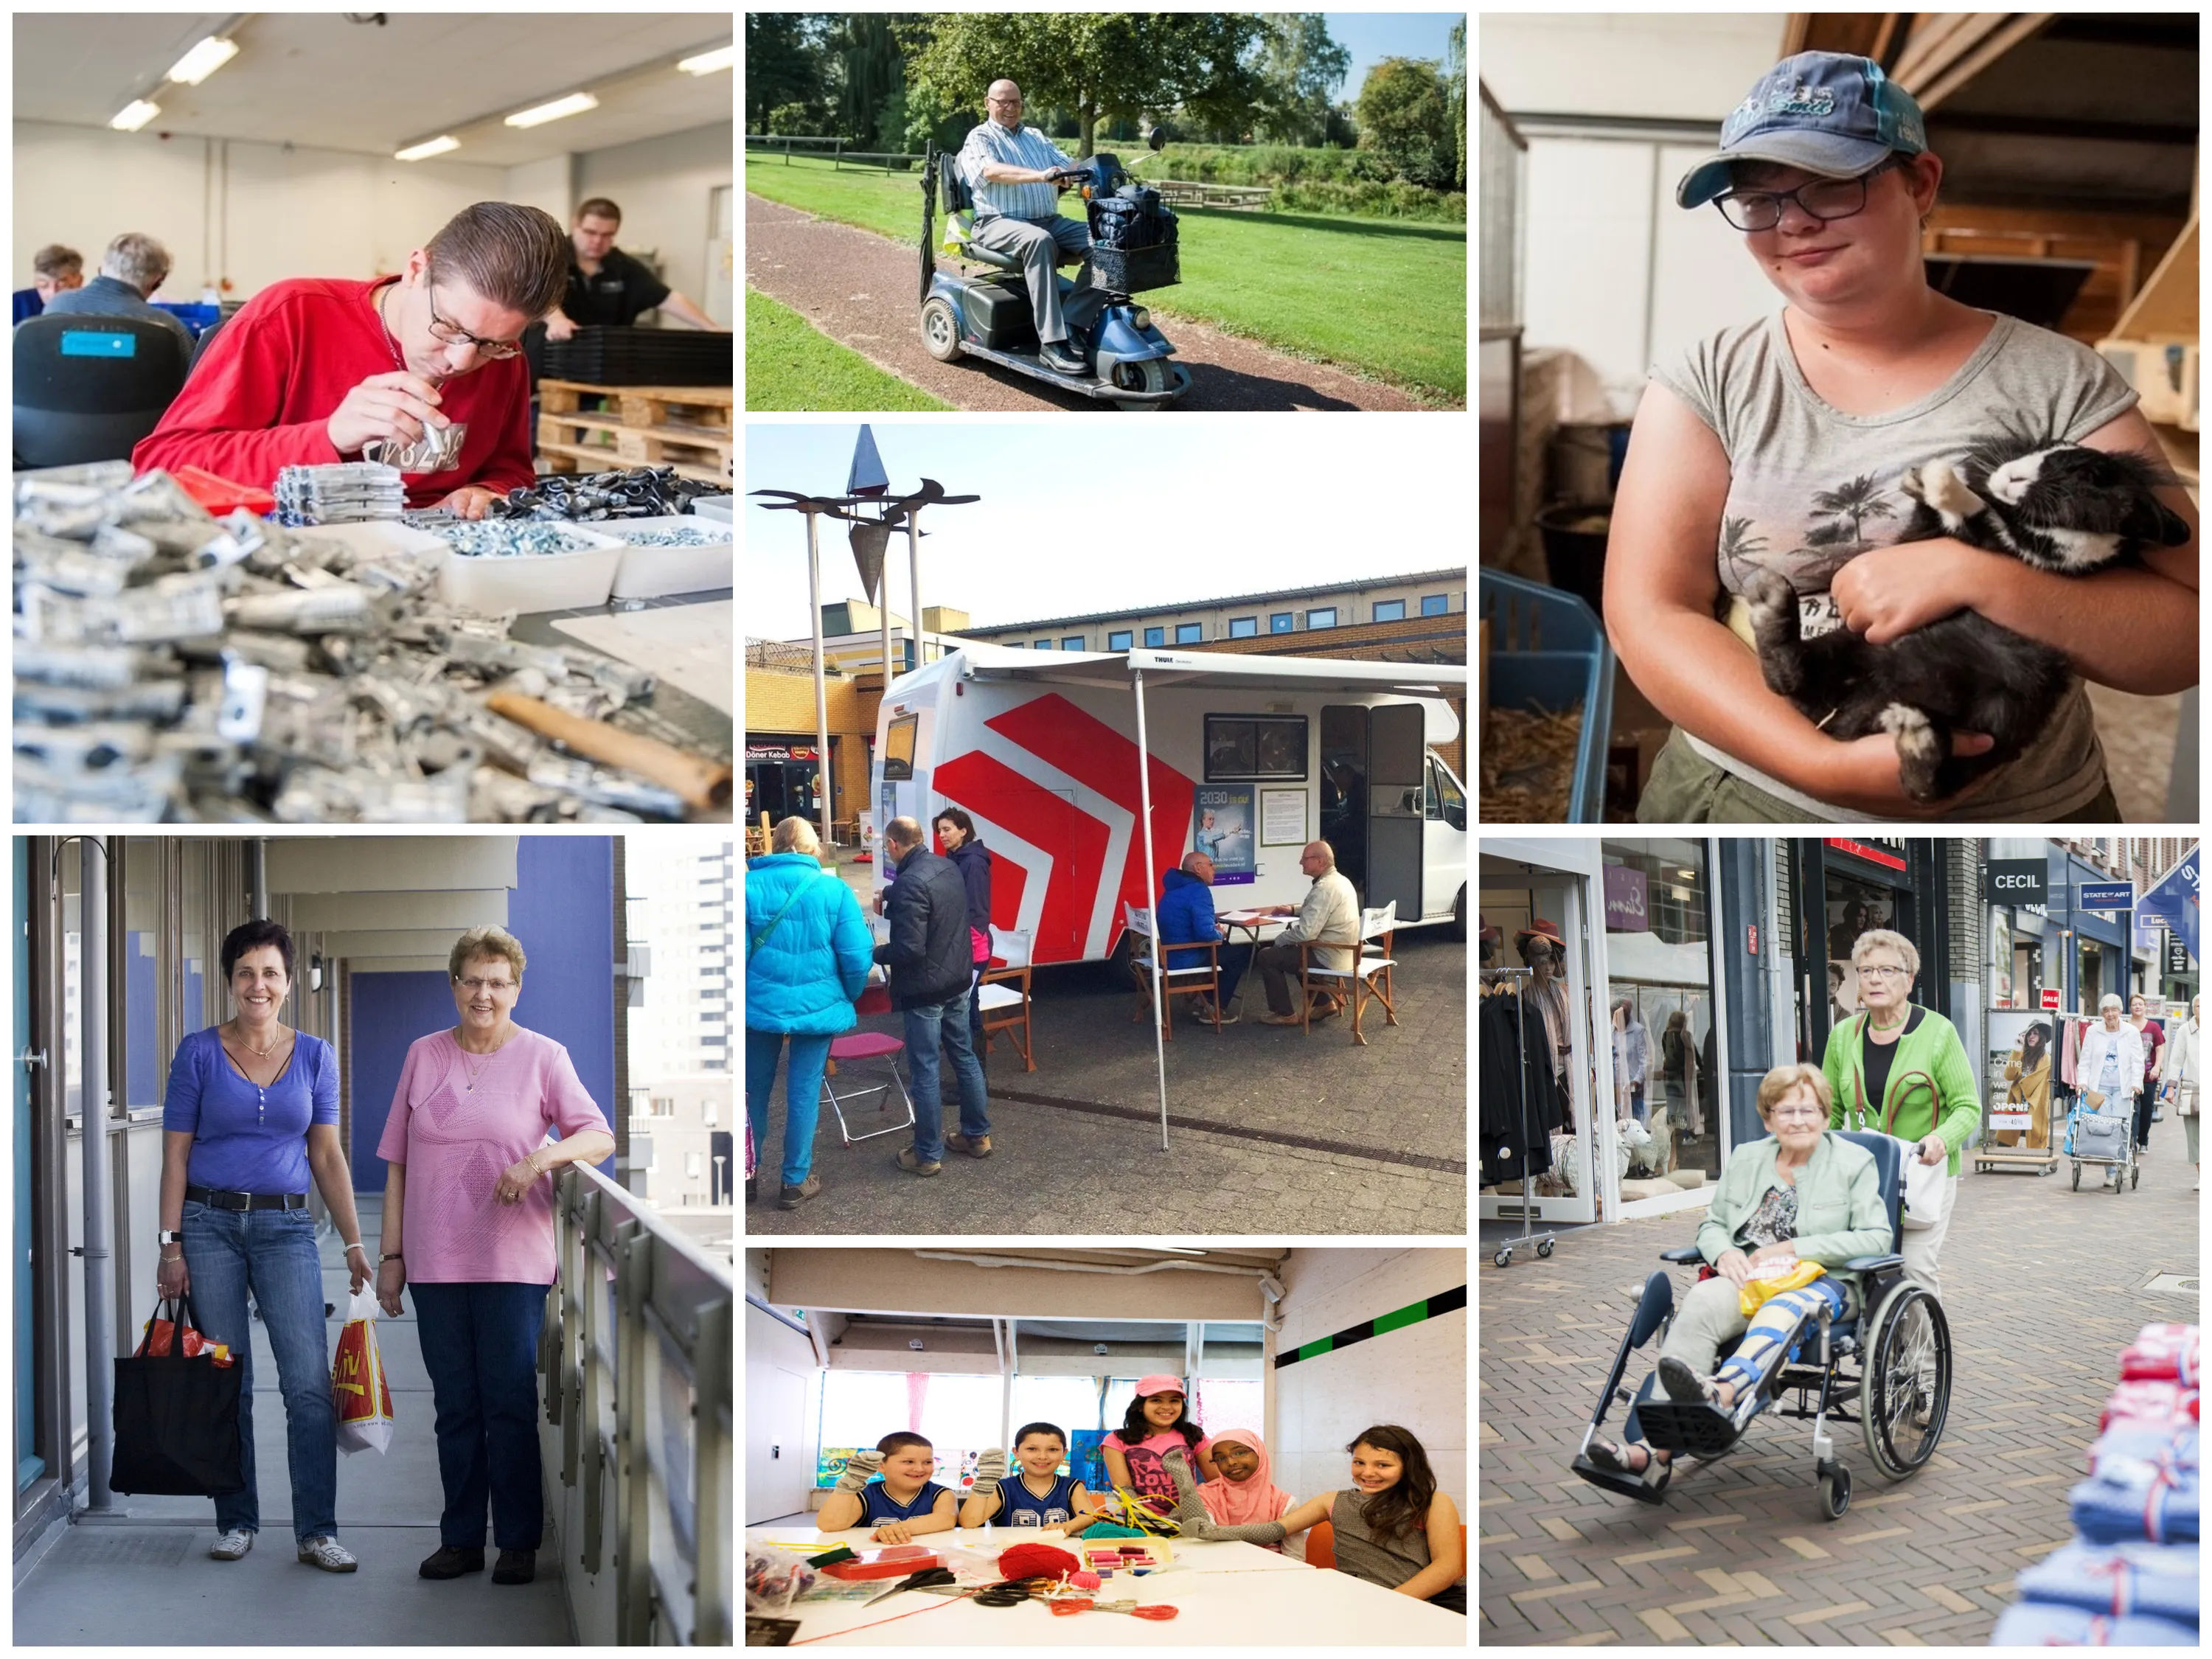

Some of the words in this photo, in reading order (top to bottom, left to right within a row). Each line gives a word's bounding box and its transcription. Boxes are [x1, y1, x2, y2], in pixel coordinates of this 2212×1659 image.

[768, 751, 790, 759] Kebab
[1200, 791, 1228, 804] 2030
[1994, 874, 2040, 888] CECIL
[1994, 1057, 2023, 1068] Come
[1993, 1068, 2001, 1078] in
[1993, 1081, 2007, 1089] we
[1993, 1091, 2007, 1100] are
